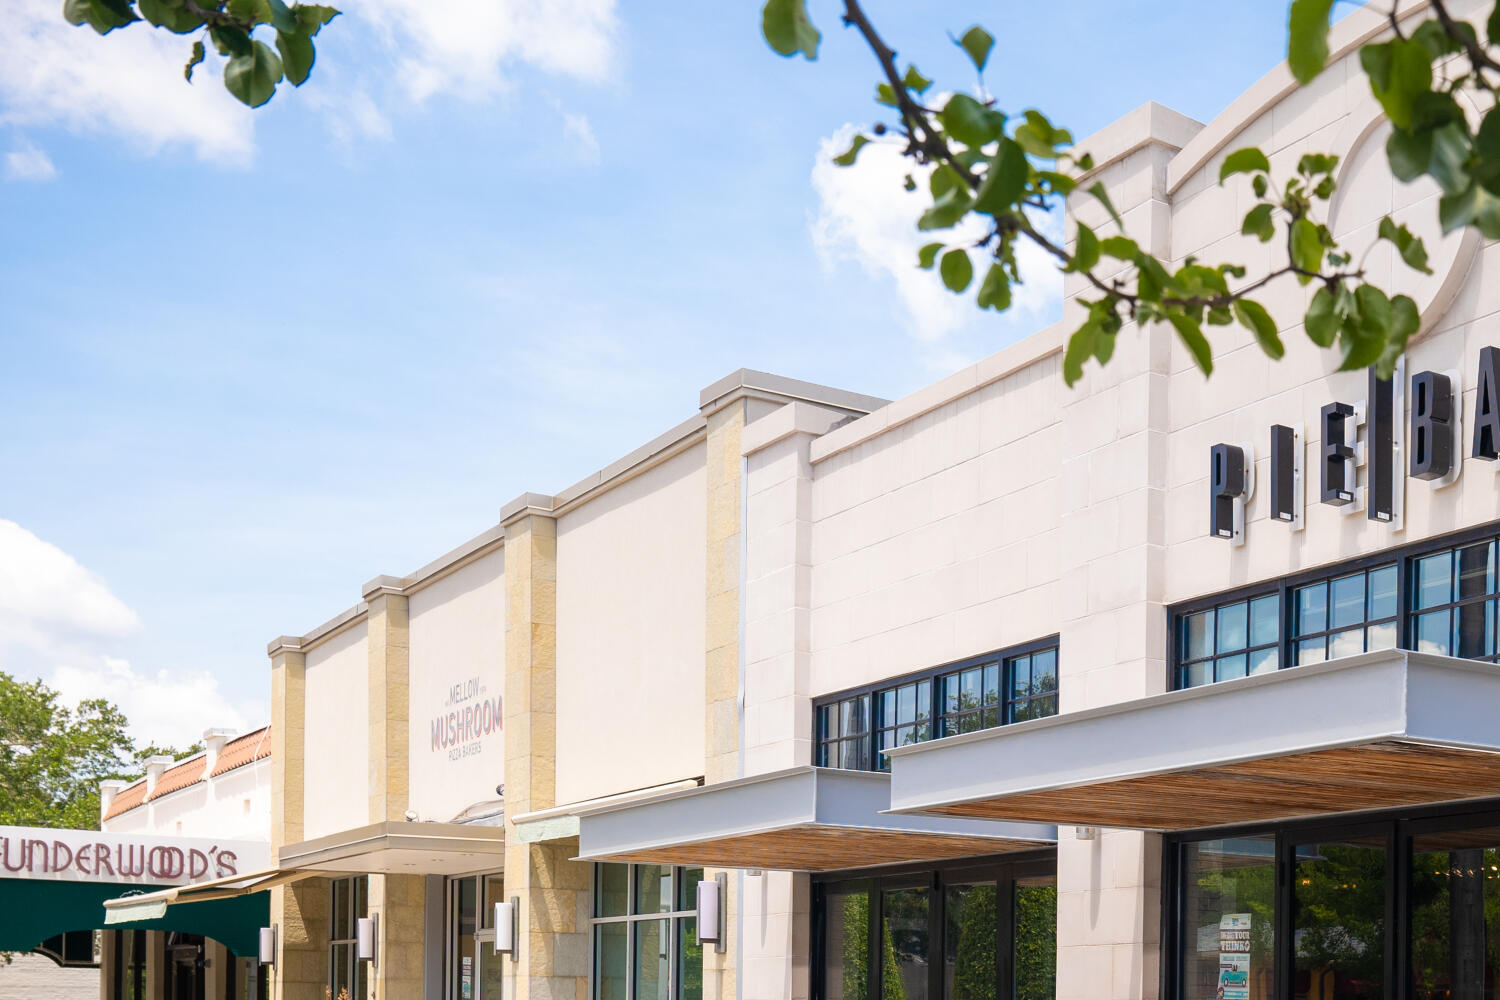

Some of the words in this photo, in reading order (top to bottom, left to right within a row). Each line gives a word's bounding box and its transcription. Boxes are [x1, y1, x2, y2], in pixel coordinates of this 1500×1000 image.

[450, 676, 480, 705] MELLOW
[431, 695, 503, 753] MUSHROOM
[3, 836, 238, 879] UNDERWOOD'S
